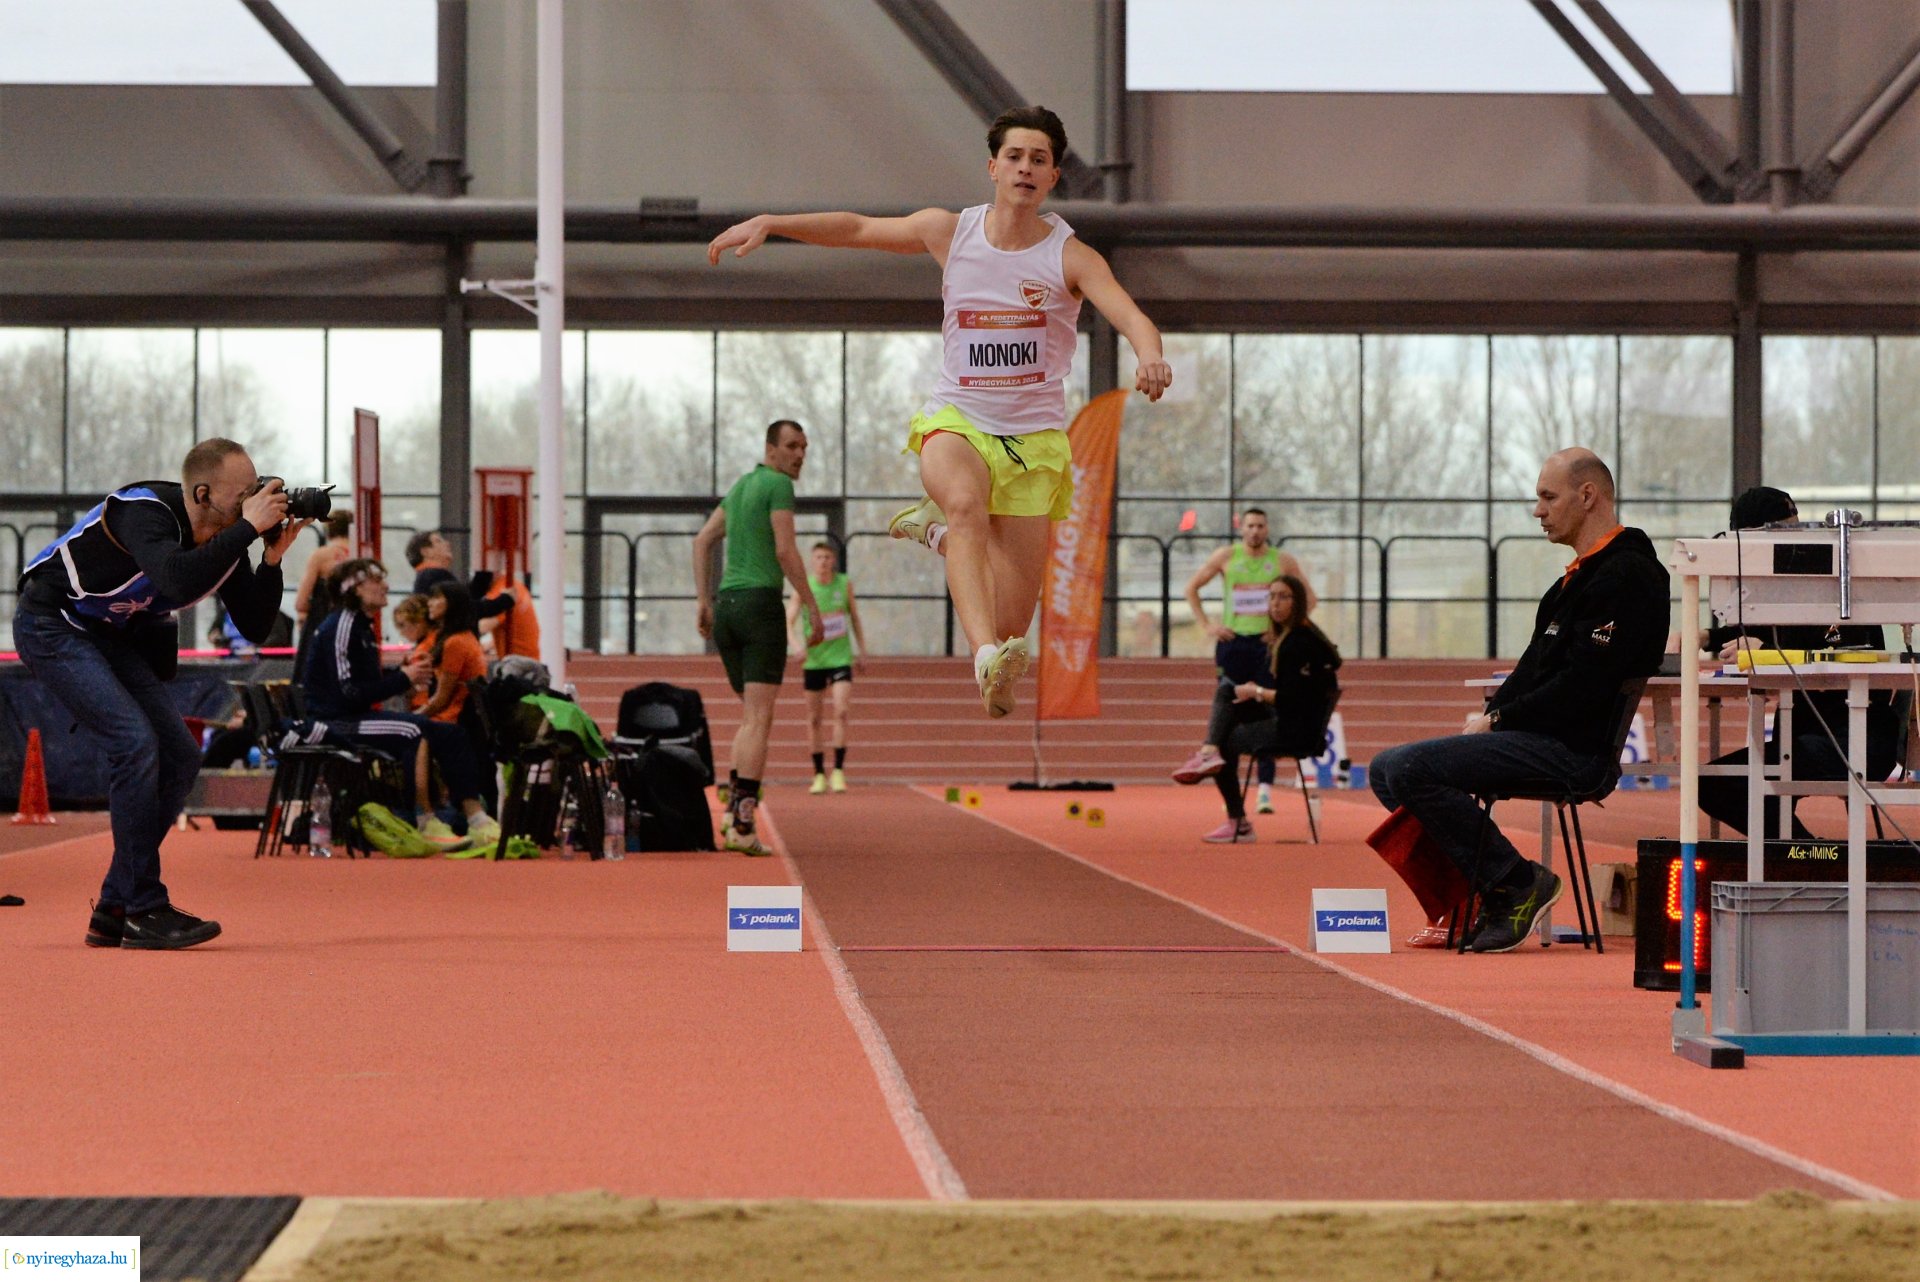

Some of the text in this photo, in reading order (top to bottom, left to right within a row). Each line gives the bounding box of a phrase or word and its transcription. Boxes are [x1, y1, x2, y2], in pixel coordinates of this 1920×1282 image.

[969, 341, 1037, 367] MONOKI
[750, 913, 795, 925] polanik
[1337, 916, 1381, 928] polanik
